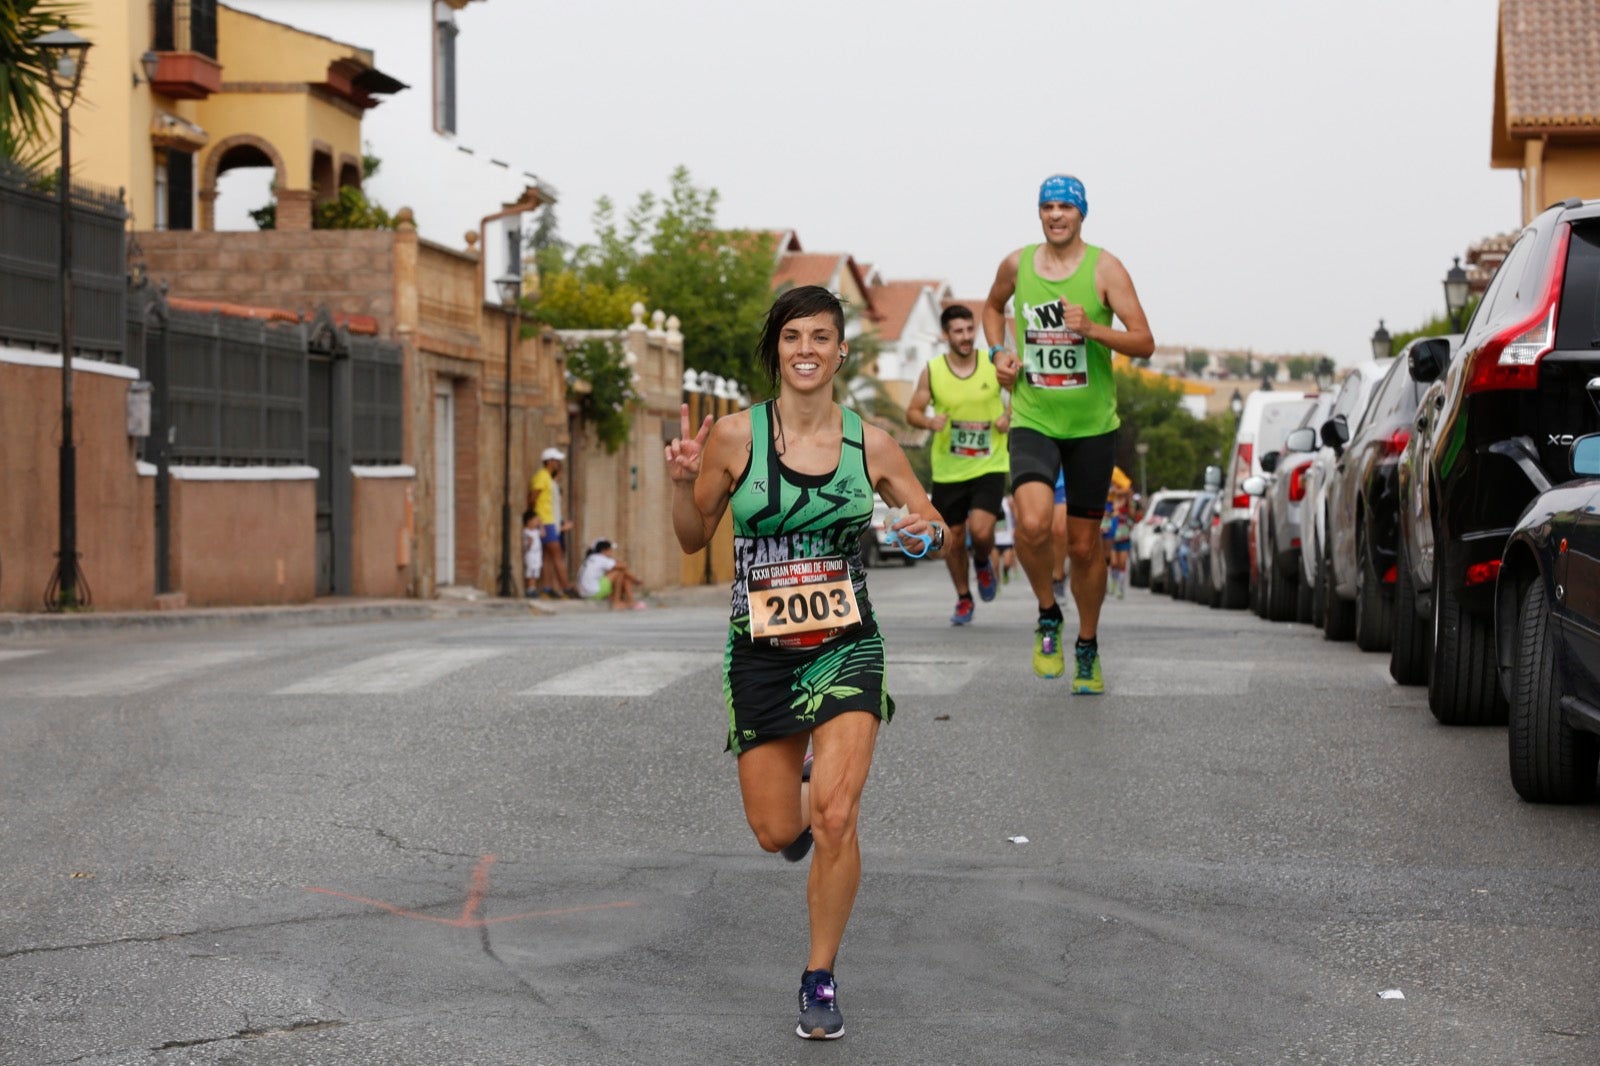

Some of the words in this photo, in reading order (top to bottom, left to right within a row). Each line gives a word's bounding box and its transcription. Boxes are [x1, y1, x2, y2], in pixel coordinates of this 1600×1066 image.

[1036, 348, 1077, 369] 166
[734, 535, 789, 577] TEAM
[751, 567, 771, 581] XXXII
[770, 565, 789, 578] GRAN
[789, 562, 813, 576] PREMIO
[813, 561, 822, 573] DE
[823, 560, 843, 572] FONDO
[766, 588, 851, 626] 2003
